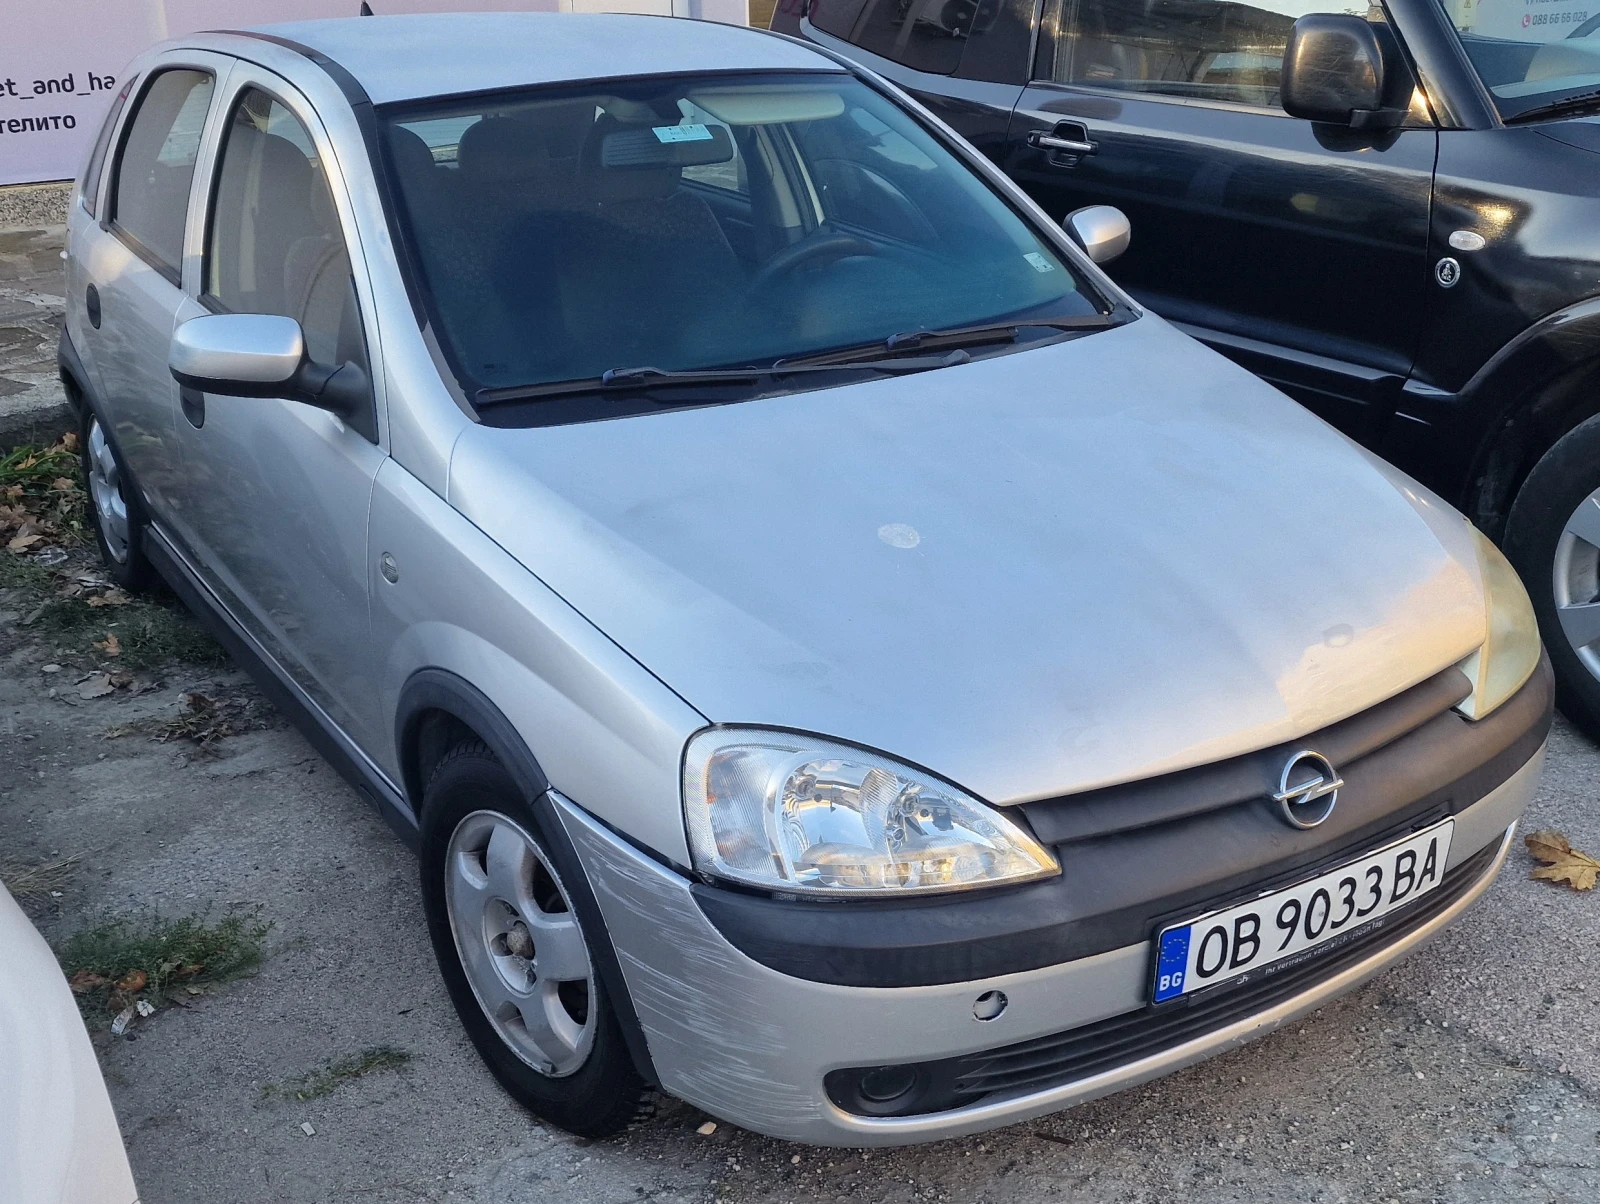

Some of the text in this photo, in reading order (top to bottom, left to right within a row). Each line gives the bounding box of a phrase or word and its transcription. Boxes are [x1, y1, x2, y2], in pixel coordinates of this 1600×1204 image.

[1532, 14, 1548, 26] 088
[1549, 13, 1560, 24] 66
[1196, 836, 1438, 979] OB 9033 BA
[1158, 970, 1183, 992] BG
